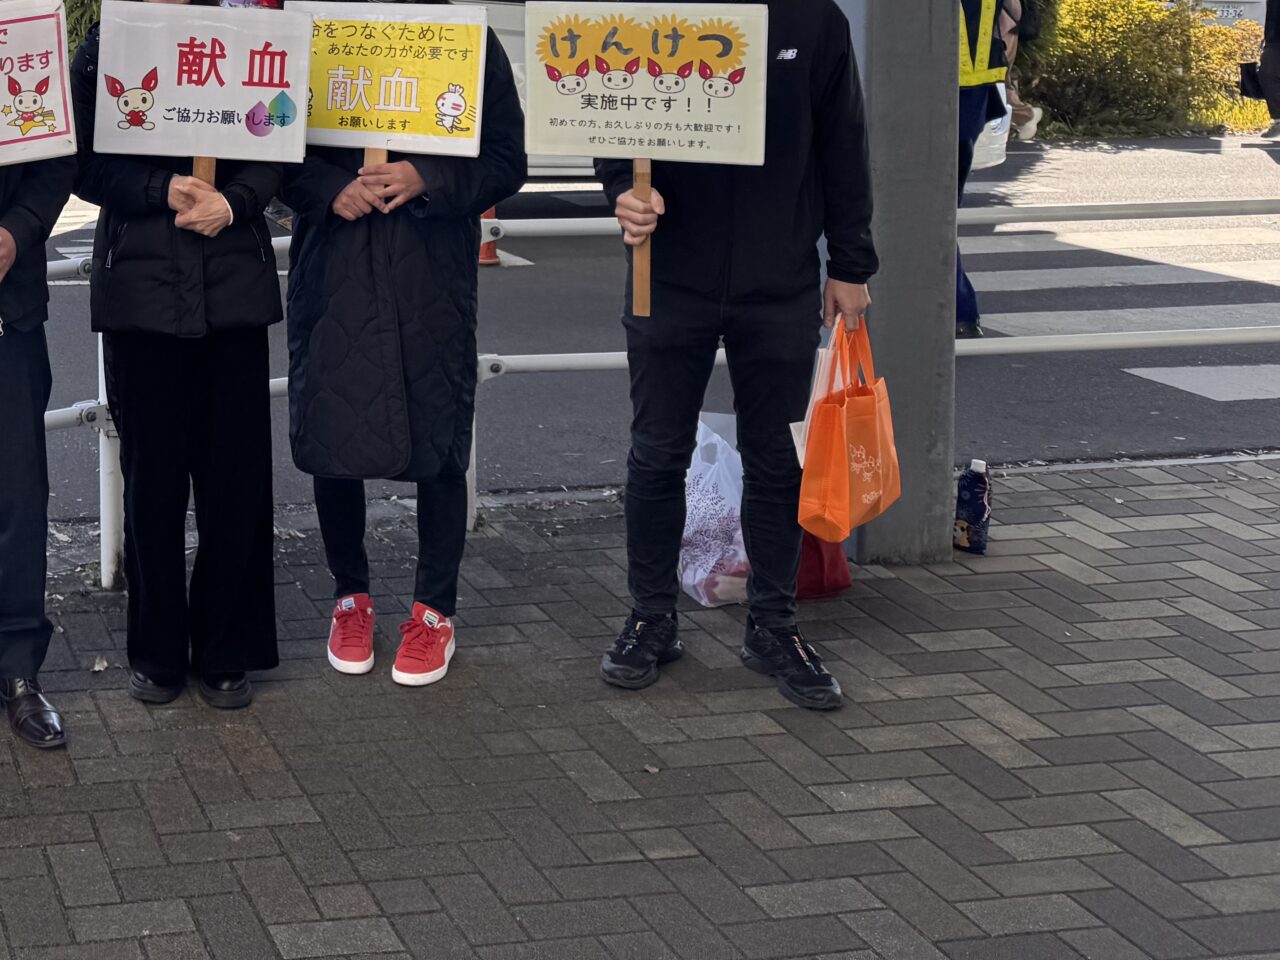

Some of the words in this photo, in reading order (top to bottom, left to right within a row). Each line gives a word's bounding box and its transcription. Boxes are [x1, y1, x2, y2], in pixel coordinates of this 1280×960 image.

[549, 26, 734, 59] けんけつ
[326, 65, 421, 113] 献血
[162, 107, 290, 128] ご協力お願いします
[338, 116, 411, 131] お願いします
